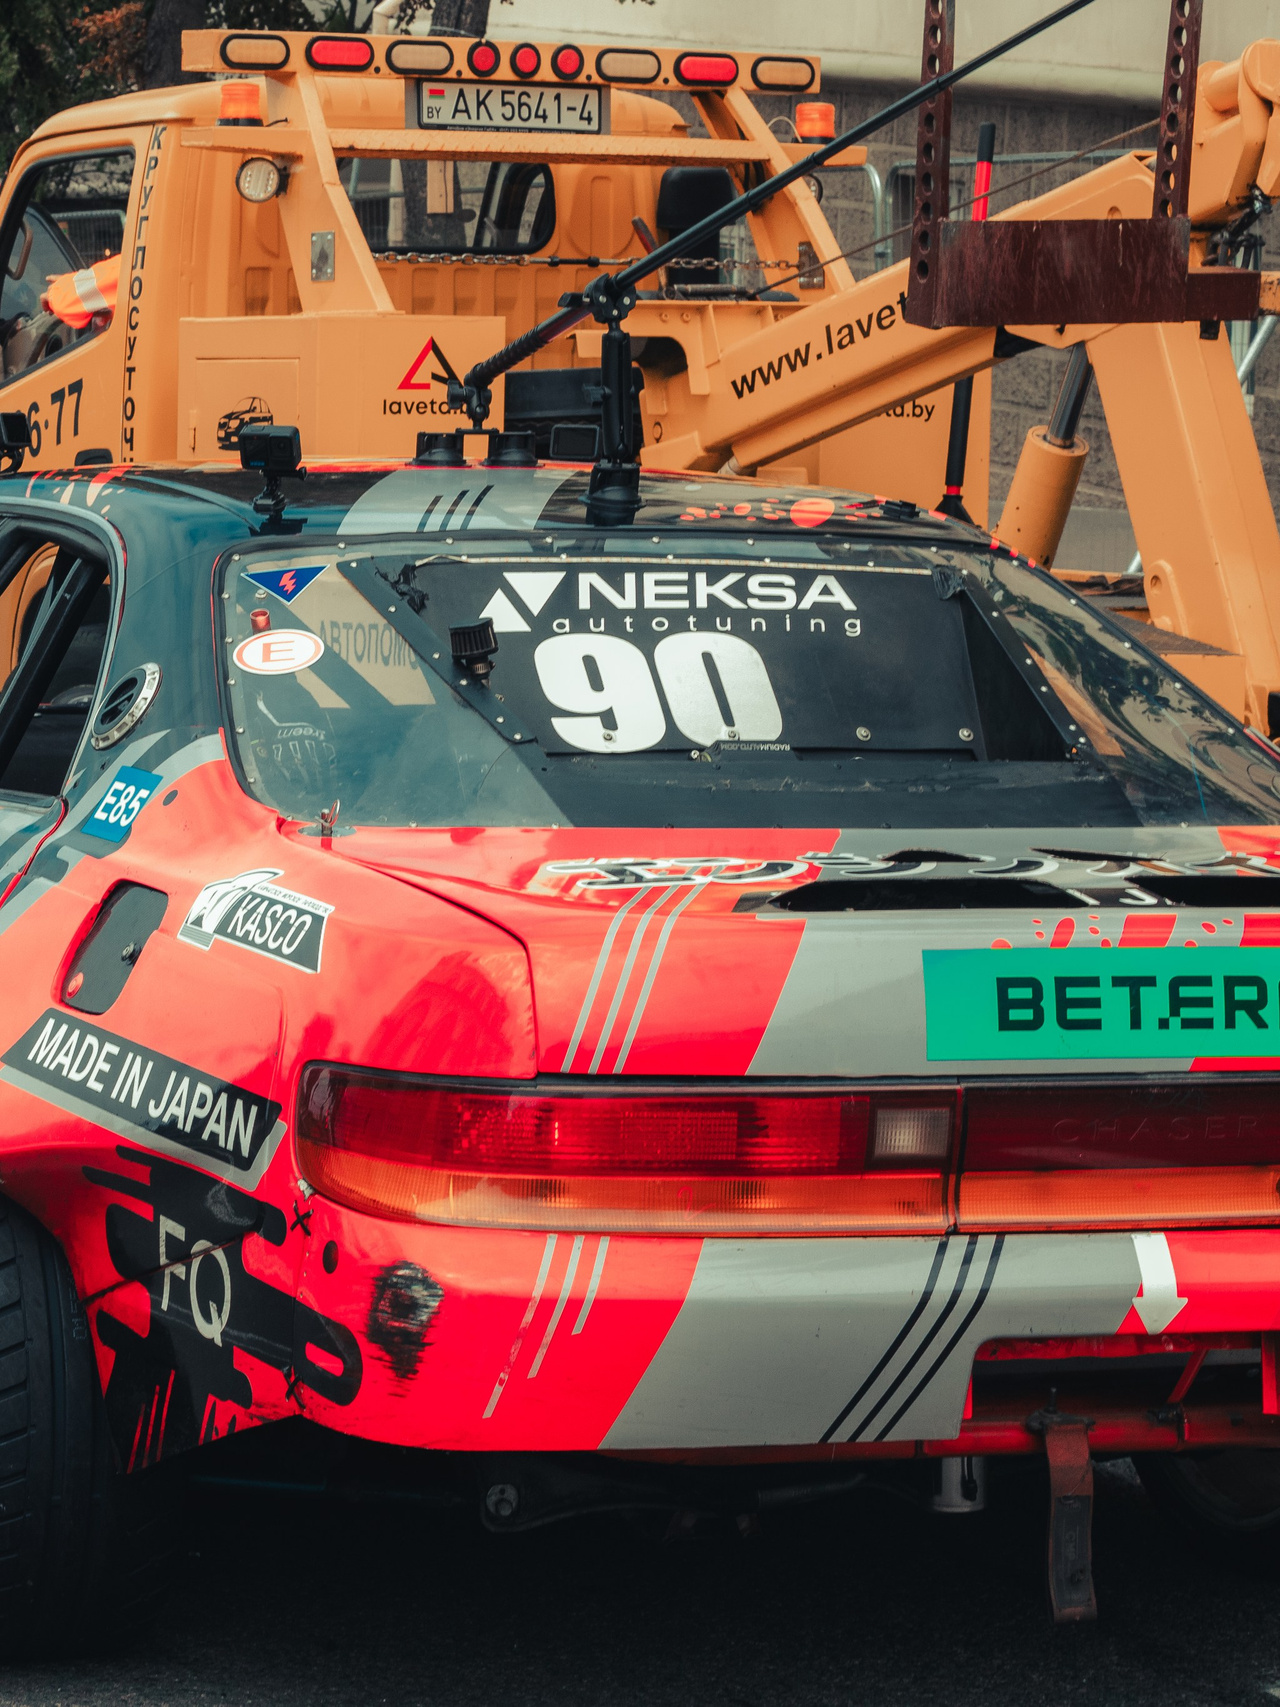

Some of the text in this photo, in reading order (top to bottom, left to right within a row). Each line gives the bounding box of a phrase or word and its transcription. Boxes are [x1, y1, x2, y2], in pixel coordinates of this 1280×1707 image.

[427, 106, 441, 119] BY
[452, 88, 593, 126] AK 5641-4
[123, 126, 167, 463] КРУГЛОСУТОЧ
[731, 290, 908, 399] www.lavet
[578, 571, 858, 612] NEKSA
[262, 640, 296, 663] E
[552, 614, 862, 637] autotuning
[534, 631, 783, 753] 90
[94, 780, 150, 827] E85
[227, 894, 313, 956] KASCO
[995, 975, 1280, 1032] BETER
[27, 1017, 258, 1158] MADE IN JAPAN
[1051, 1116, 1263, 1143] CHASER
[158, 1214, 231, 1347] FQ
